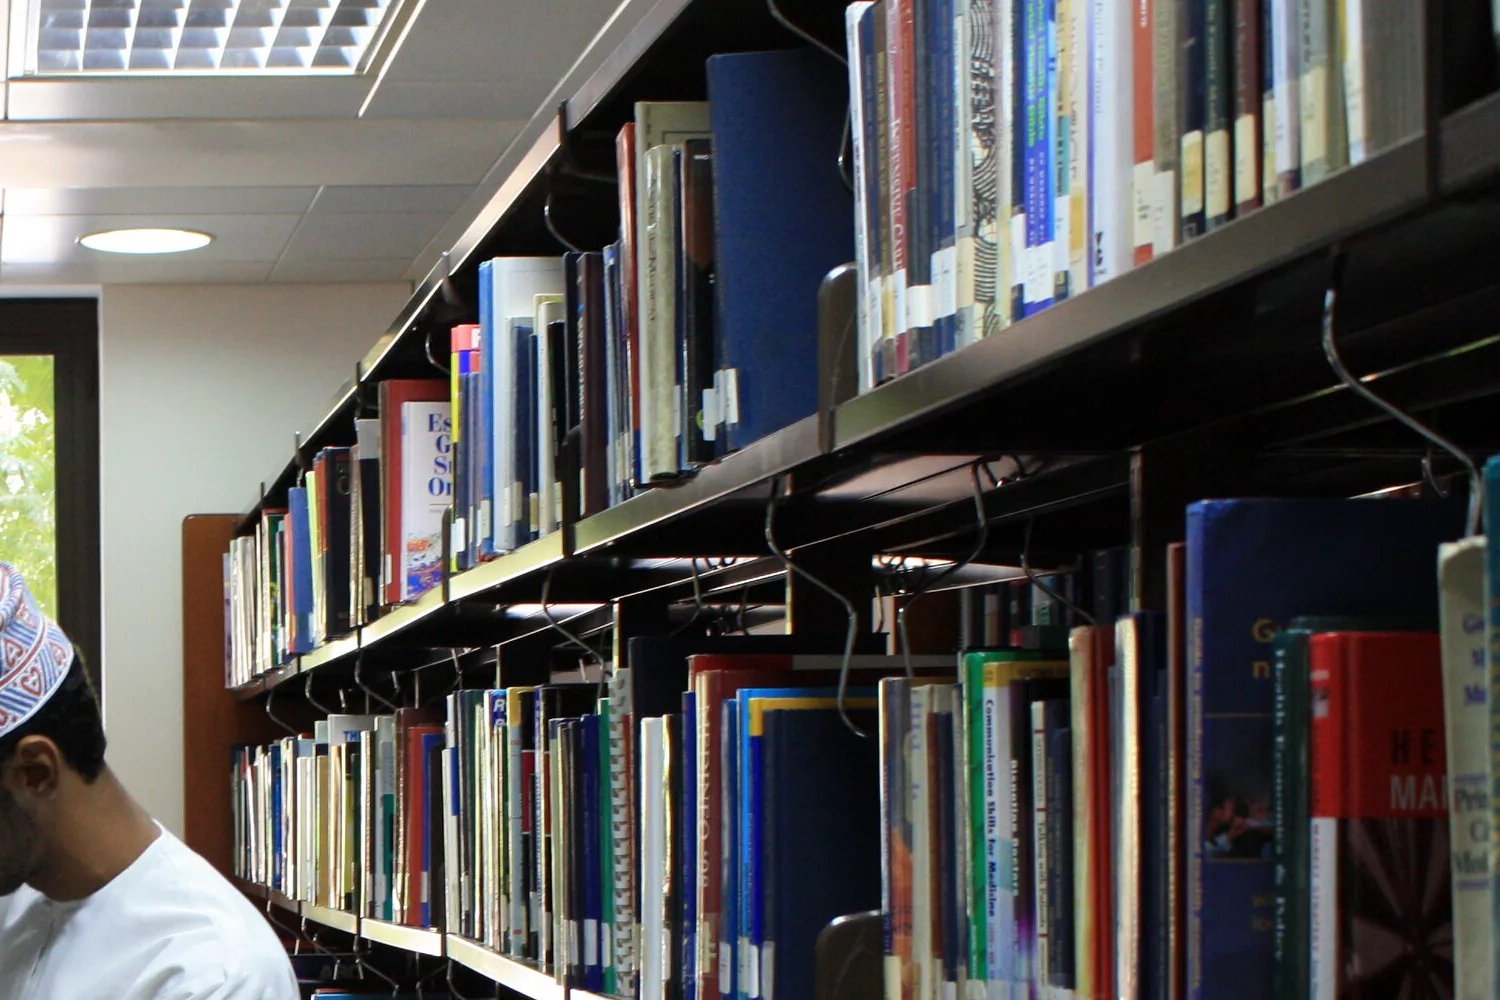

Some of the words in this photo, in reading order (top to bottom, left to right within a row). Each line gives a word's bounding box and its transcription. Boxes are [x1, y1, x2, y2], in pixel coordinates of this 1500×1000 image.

[890, 117, 902, 219] INTENSIVE
[891, 222, 905, 270] CARE
[987, 699, 996, 798] Communication
[987, 801, 997, 835] Skills
[988, 838, 997, 858] for
[988, 861, 998, 918] Medicine
